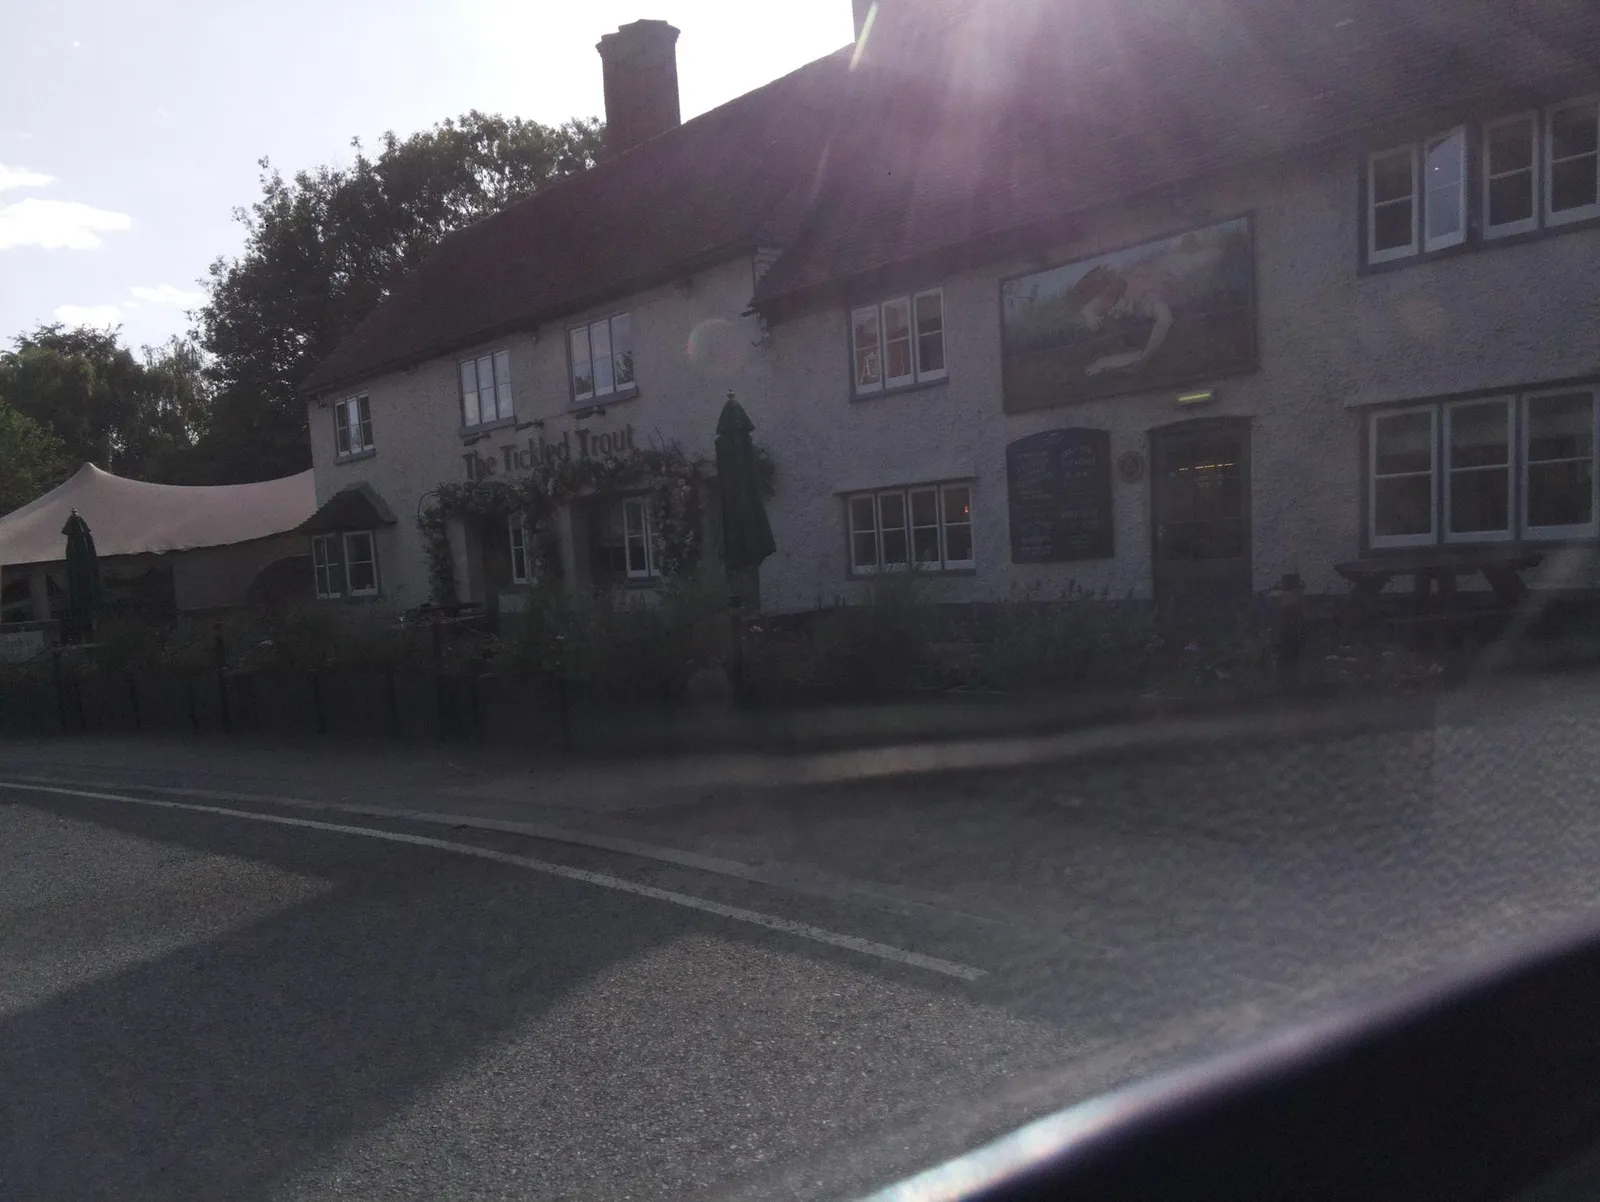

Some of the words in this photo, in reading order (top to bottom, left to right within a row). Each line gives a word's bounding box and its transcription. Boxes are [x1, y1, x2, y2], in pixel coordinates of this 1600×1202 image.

[462, 450, 497, 480] The
[500, 431, 571, 471] Tickled
[575, 424, 635, 460] Trout
